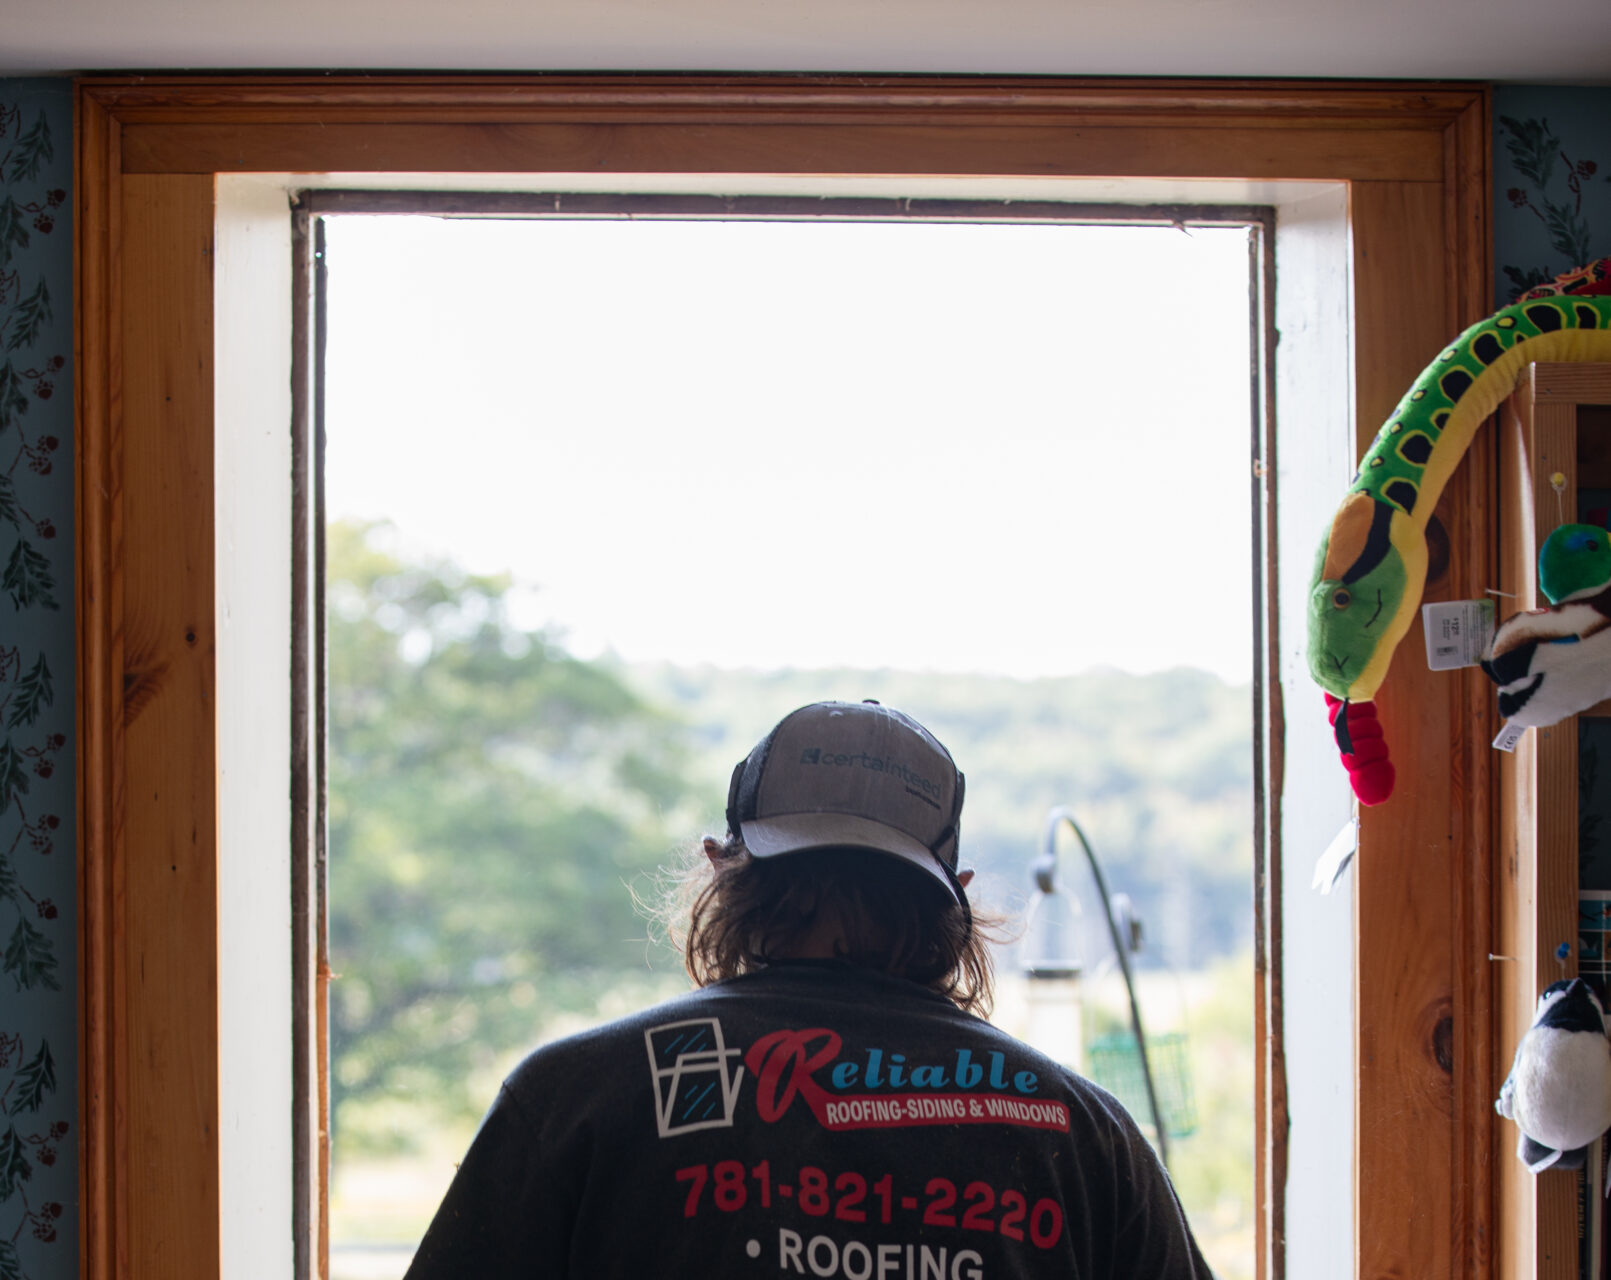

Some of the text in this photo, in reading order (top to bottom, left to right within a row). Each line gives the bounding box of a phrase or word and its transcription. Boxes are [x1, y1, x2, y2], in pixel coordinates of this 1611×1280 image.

[744, 1028, 1039, 1123] Reliable
[969, 1101, 984, 1117] &
[985, 1099, 1067, 1127] WINDOWS
[675, 1159, 1064, 1250] 781-821-2220
